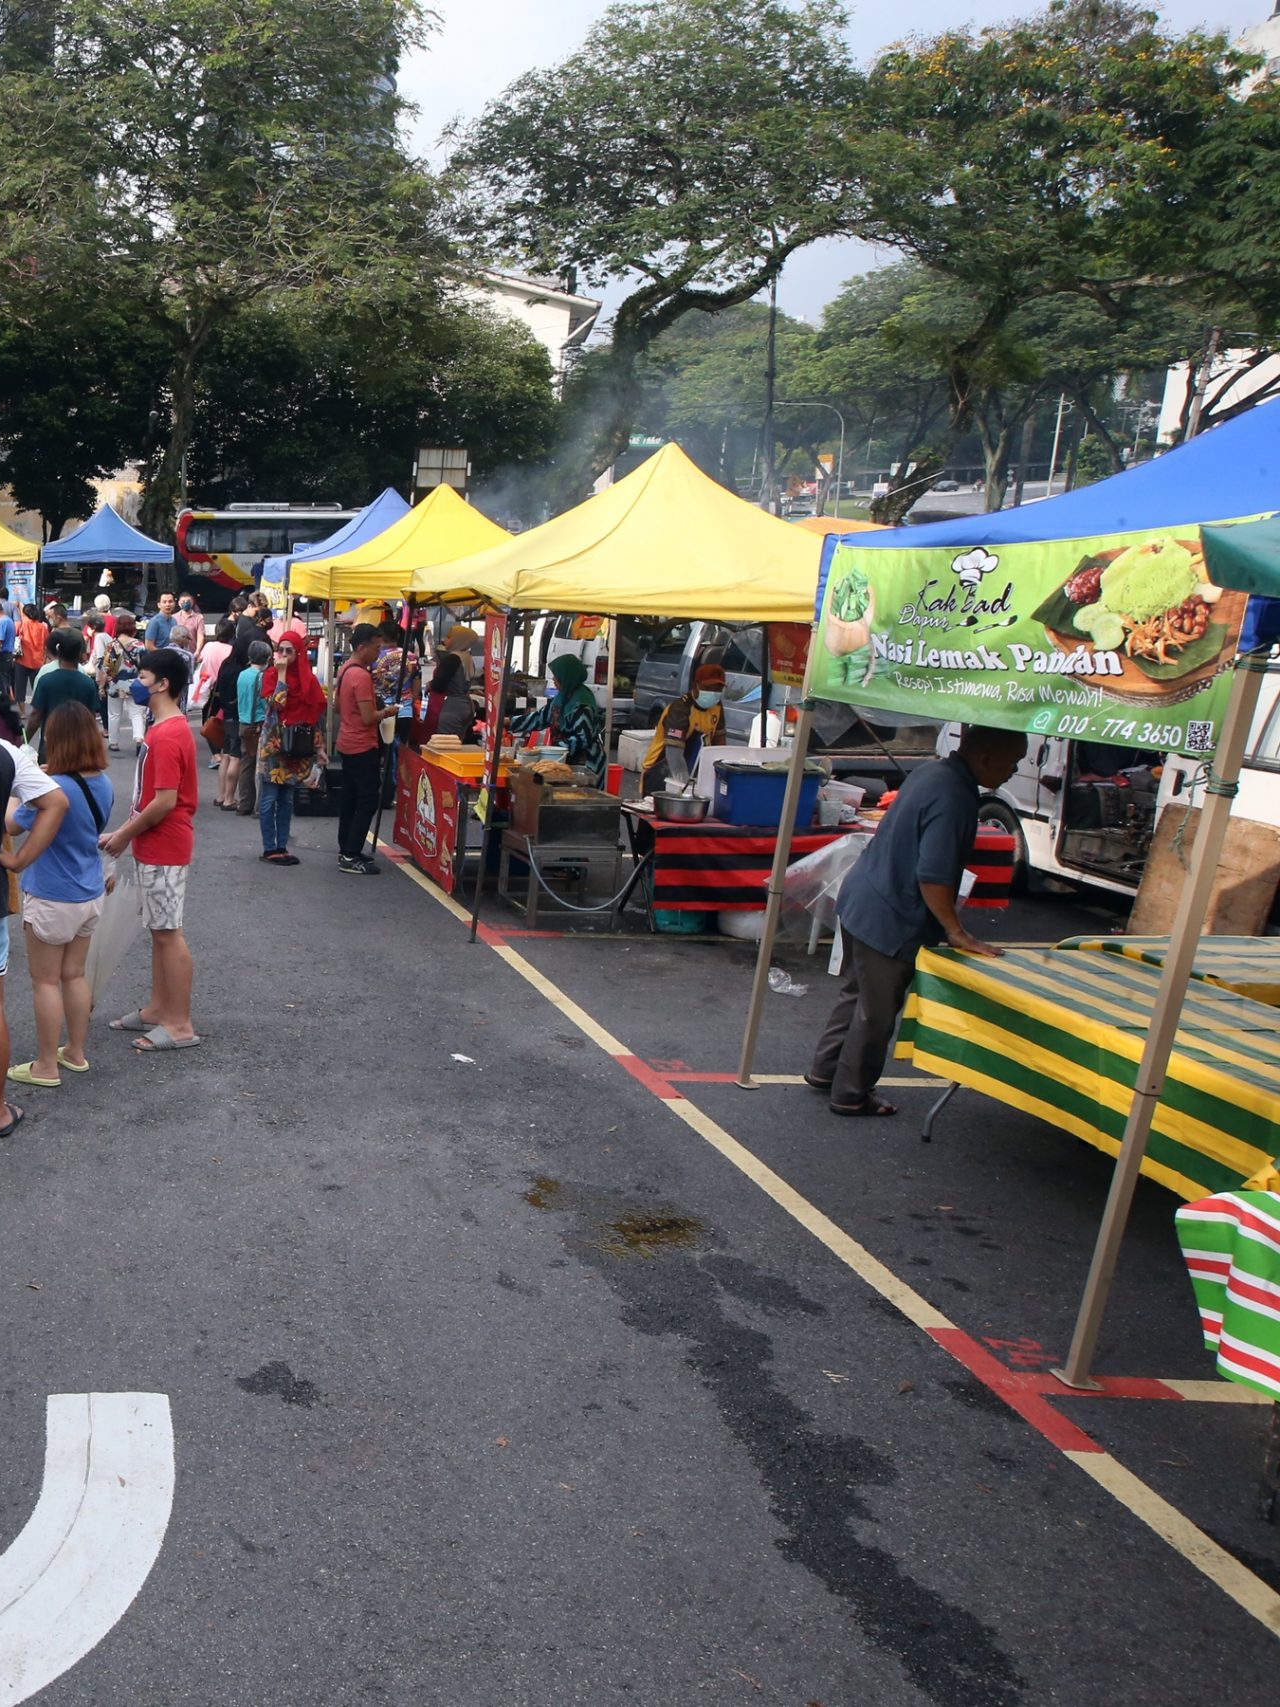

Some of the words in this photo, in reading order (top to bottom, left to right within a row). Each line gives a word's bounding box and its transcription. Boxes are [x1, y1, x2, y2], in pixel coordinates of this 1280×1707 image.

[898, 603, 952, 637] Dapur
[871, 633, 913, 665] Nasi
[916, 640, 1009, 672] Lemak
[1007, 643, 1124, 676] Pandan
[894, 671, 934, 693] Resepi
[937, 677, 1002, 702] Istimewa,
[1006, 681, 1035, 702] Rasa
[1039, 685, 1104, 709] Mewah!
[1057, 715, 1089, 734] 010
[1100, 719, 1137, 740] 774
[1137, 723, 1182, 748] 3650
